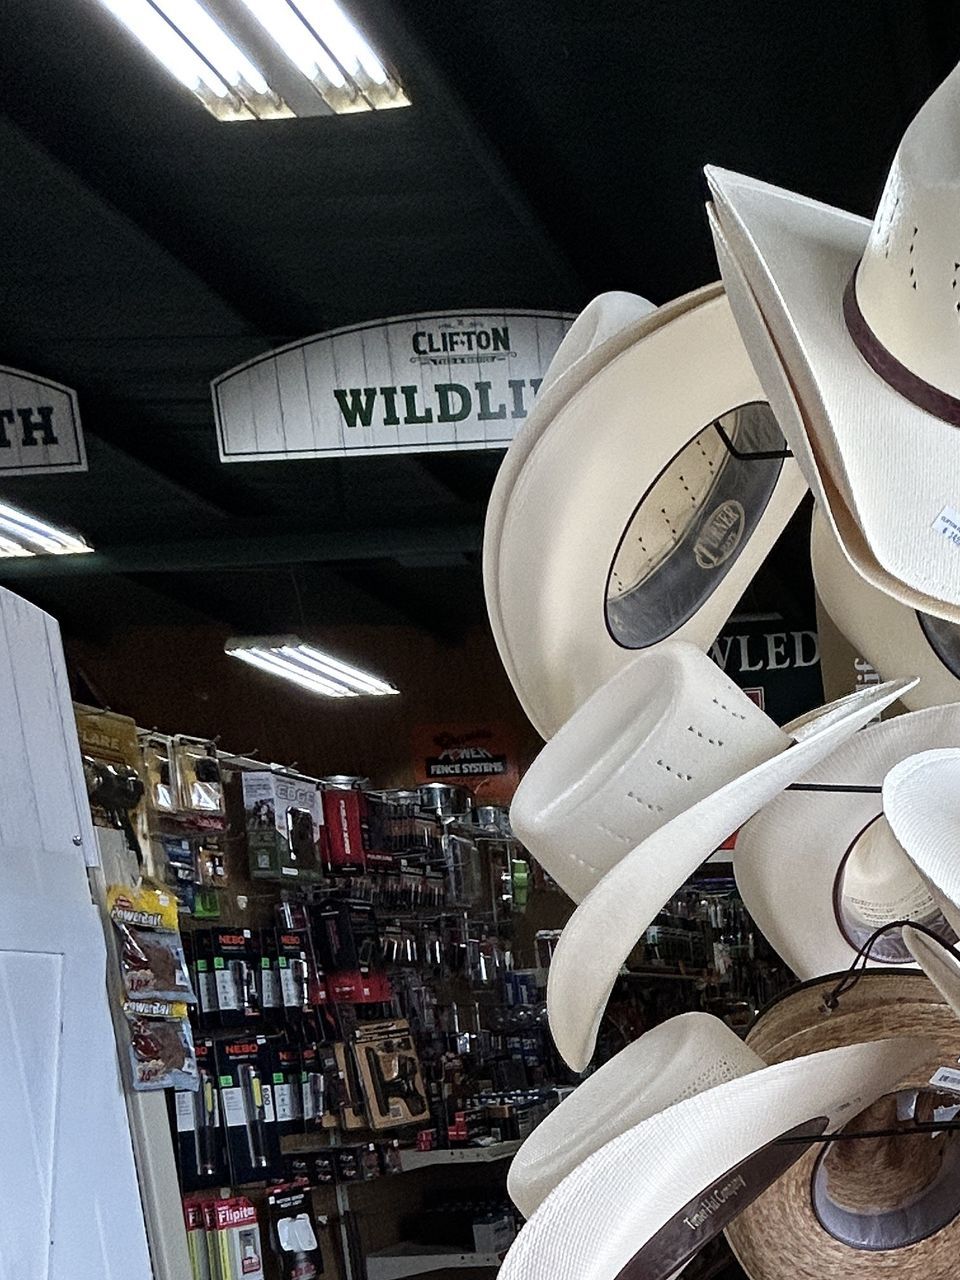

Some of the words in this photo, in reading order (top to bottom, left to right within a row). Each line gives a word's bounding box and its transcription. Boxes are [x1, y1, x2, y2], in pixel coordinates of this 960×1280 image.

[412, 327, 511, 355] CLIFTON
[431, 763, 461, 775] FENCE
[462, 761, 504, 773] SYSTEMS
[111, 906, 163, 926] PowerBait
[219, 935, 245, 946] NEBO
[225, 1044, 259, 1055] NEBO
